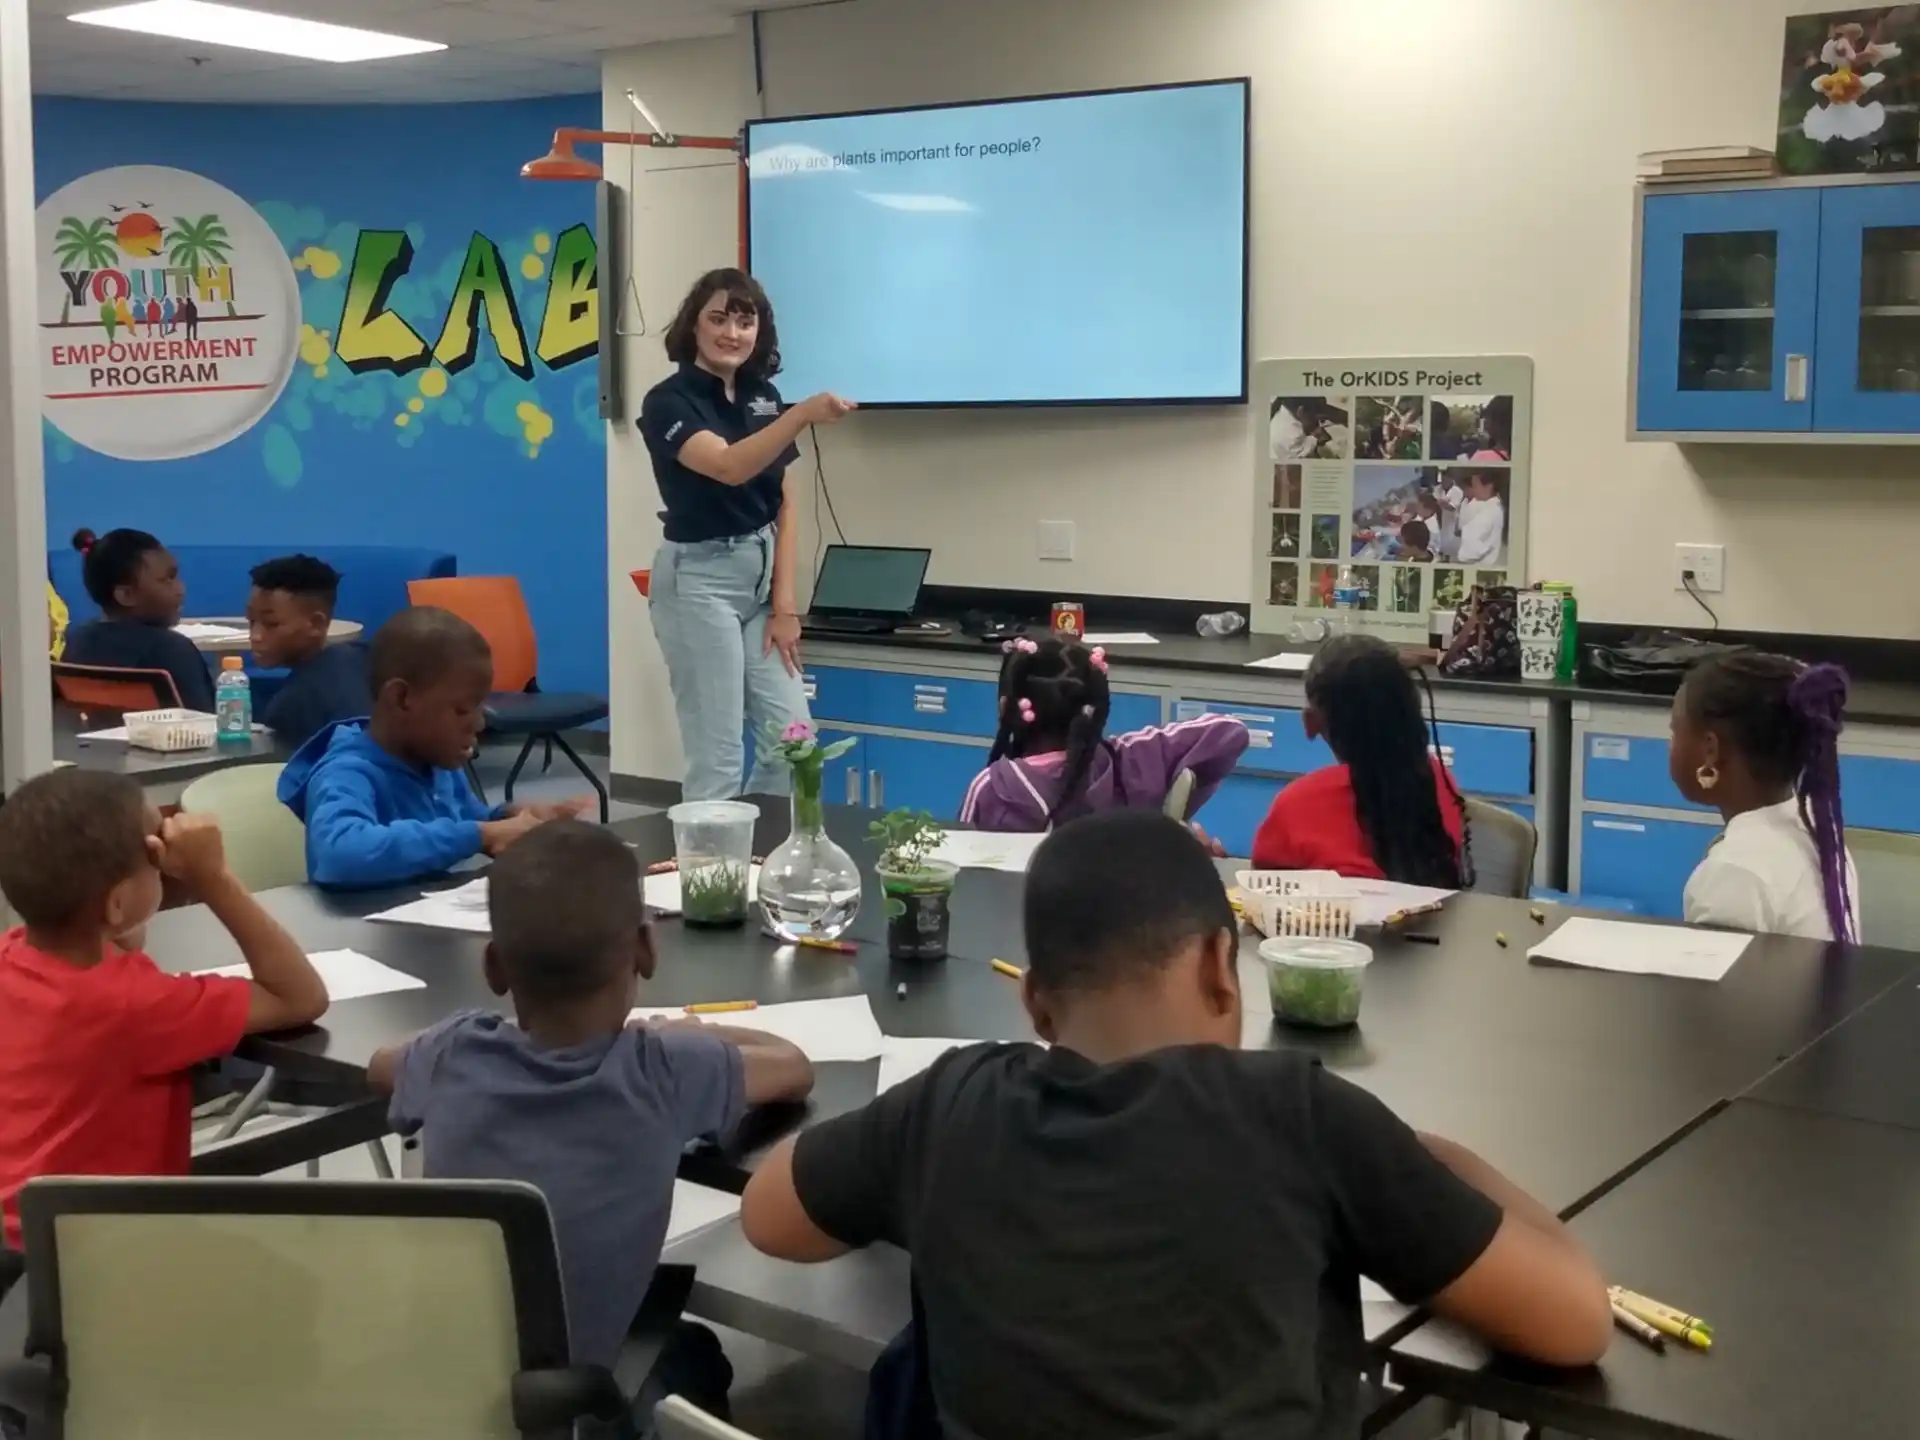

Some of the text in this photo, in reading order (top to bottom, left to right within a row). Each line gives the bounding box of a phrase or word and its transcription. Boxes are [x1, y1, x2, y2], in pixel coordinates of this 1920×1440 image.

[770, 136, 1041, 171] Why are plants important for people?
[60, 264, 236, 306] YOUTH
[335, 222, 599, 381] LAB
[52, 337, 258, 366] EMPOWERMENT
[90, 363, 218, 387] PROGRAM
[1302, 370, 1483, 390] The OrKIDS Project
